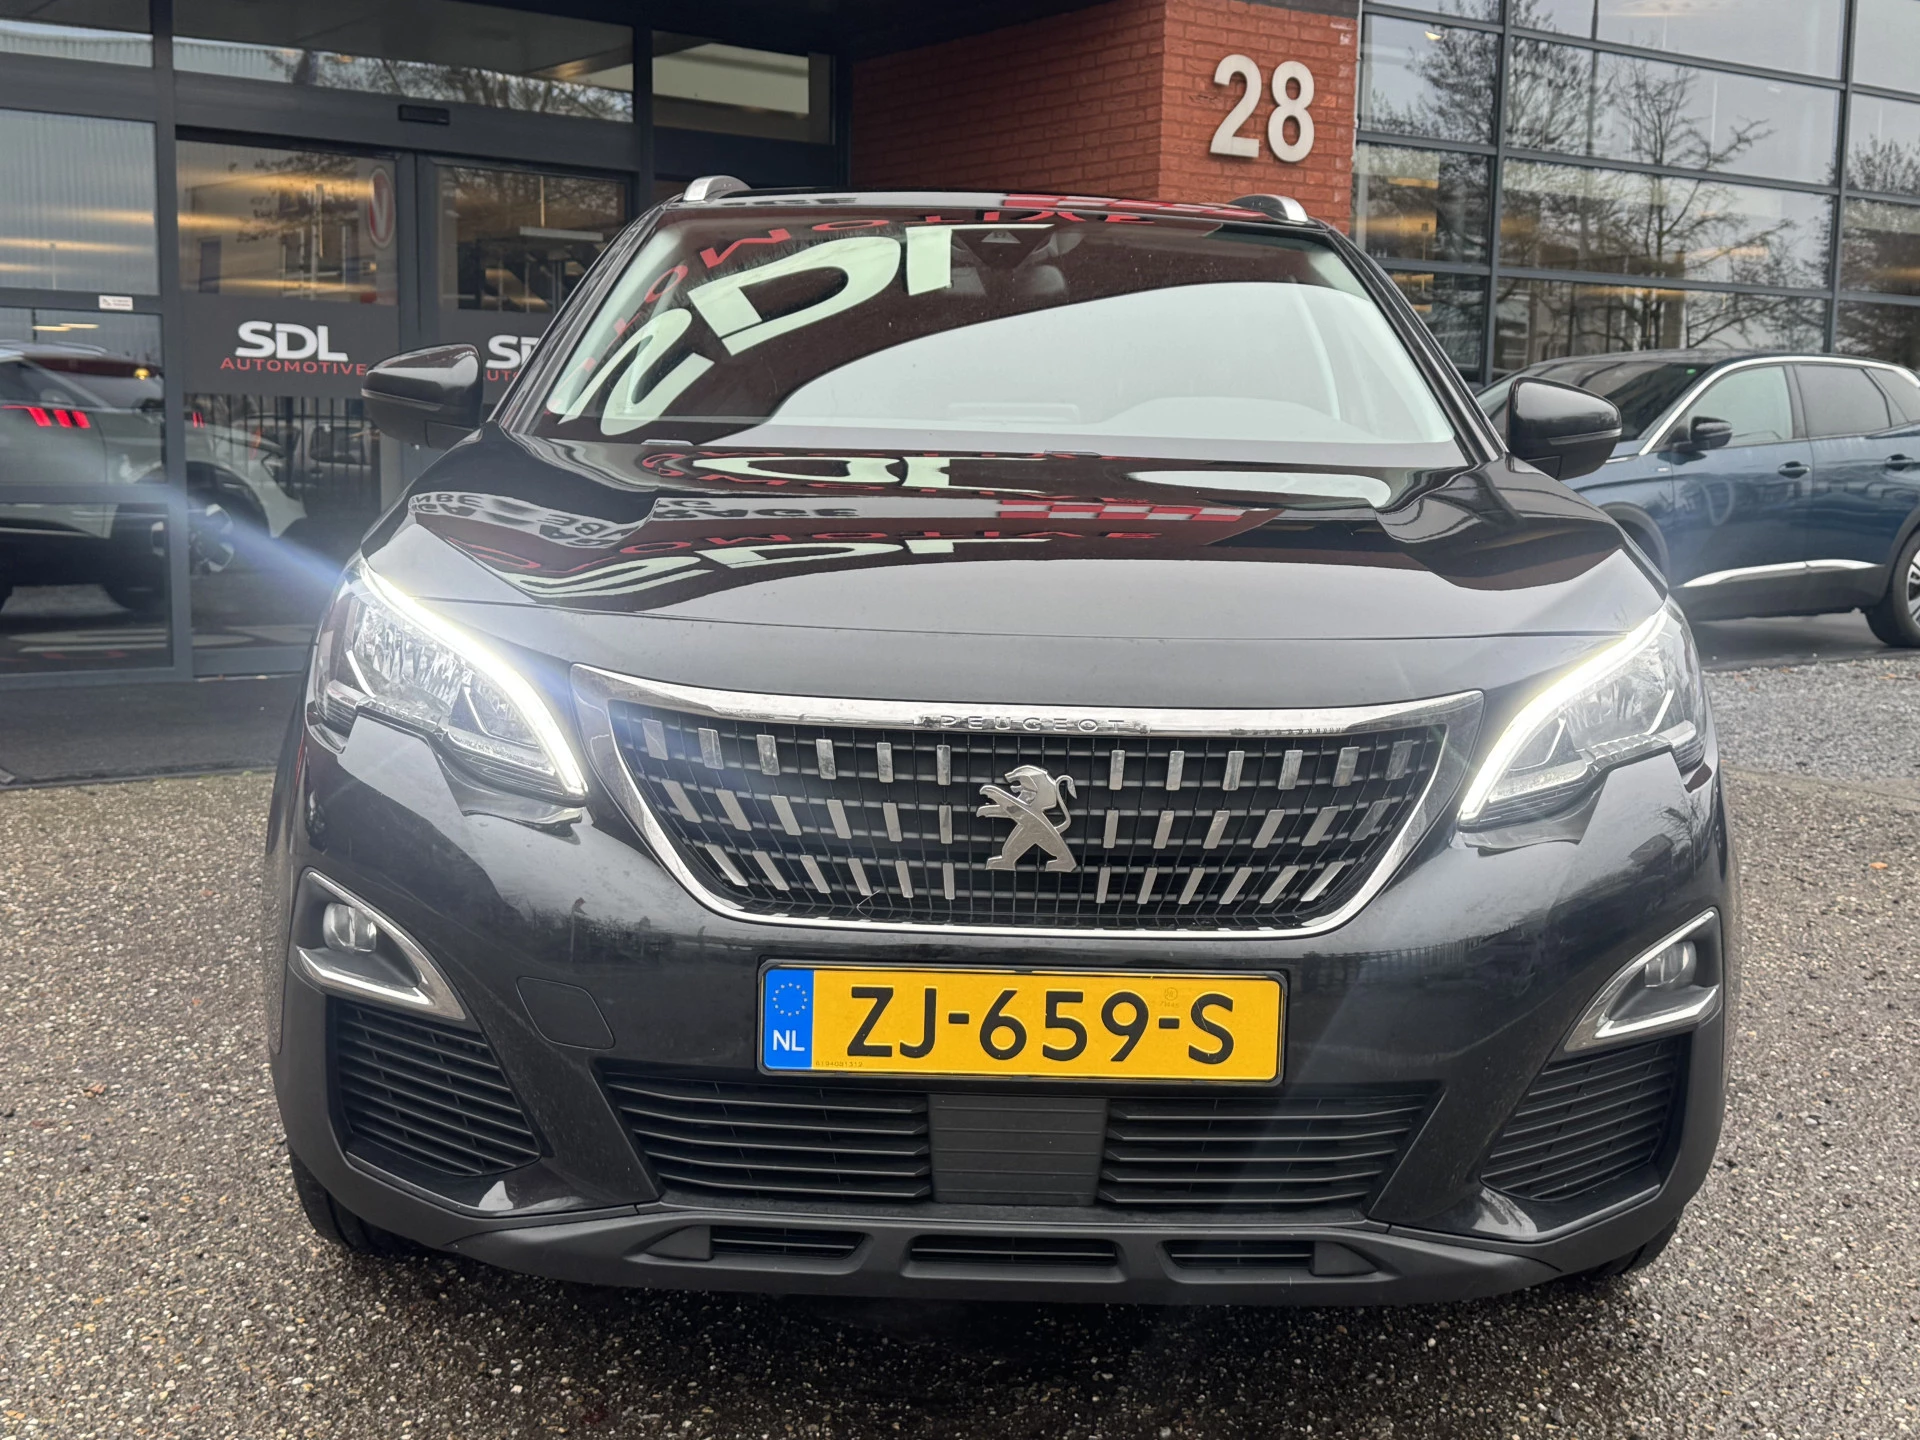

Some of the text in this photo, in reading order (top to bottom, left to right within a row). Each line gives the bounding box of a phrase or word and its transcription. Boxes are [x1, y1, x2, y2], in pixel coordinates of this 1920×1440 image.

[1209, 53, 1315, 162] 28
[235, 320, 349, 362] SDL
[220, 357, 367, 376] AUTOMOTIVE
[940, 715, 1124, 733] PEUGEOT
[773, 1029, 806, 1051] NL
[846, 986, 1236, 1064] ZJ-659-S
